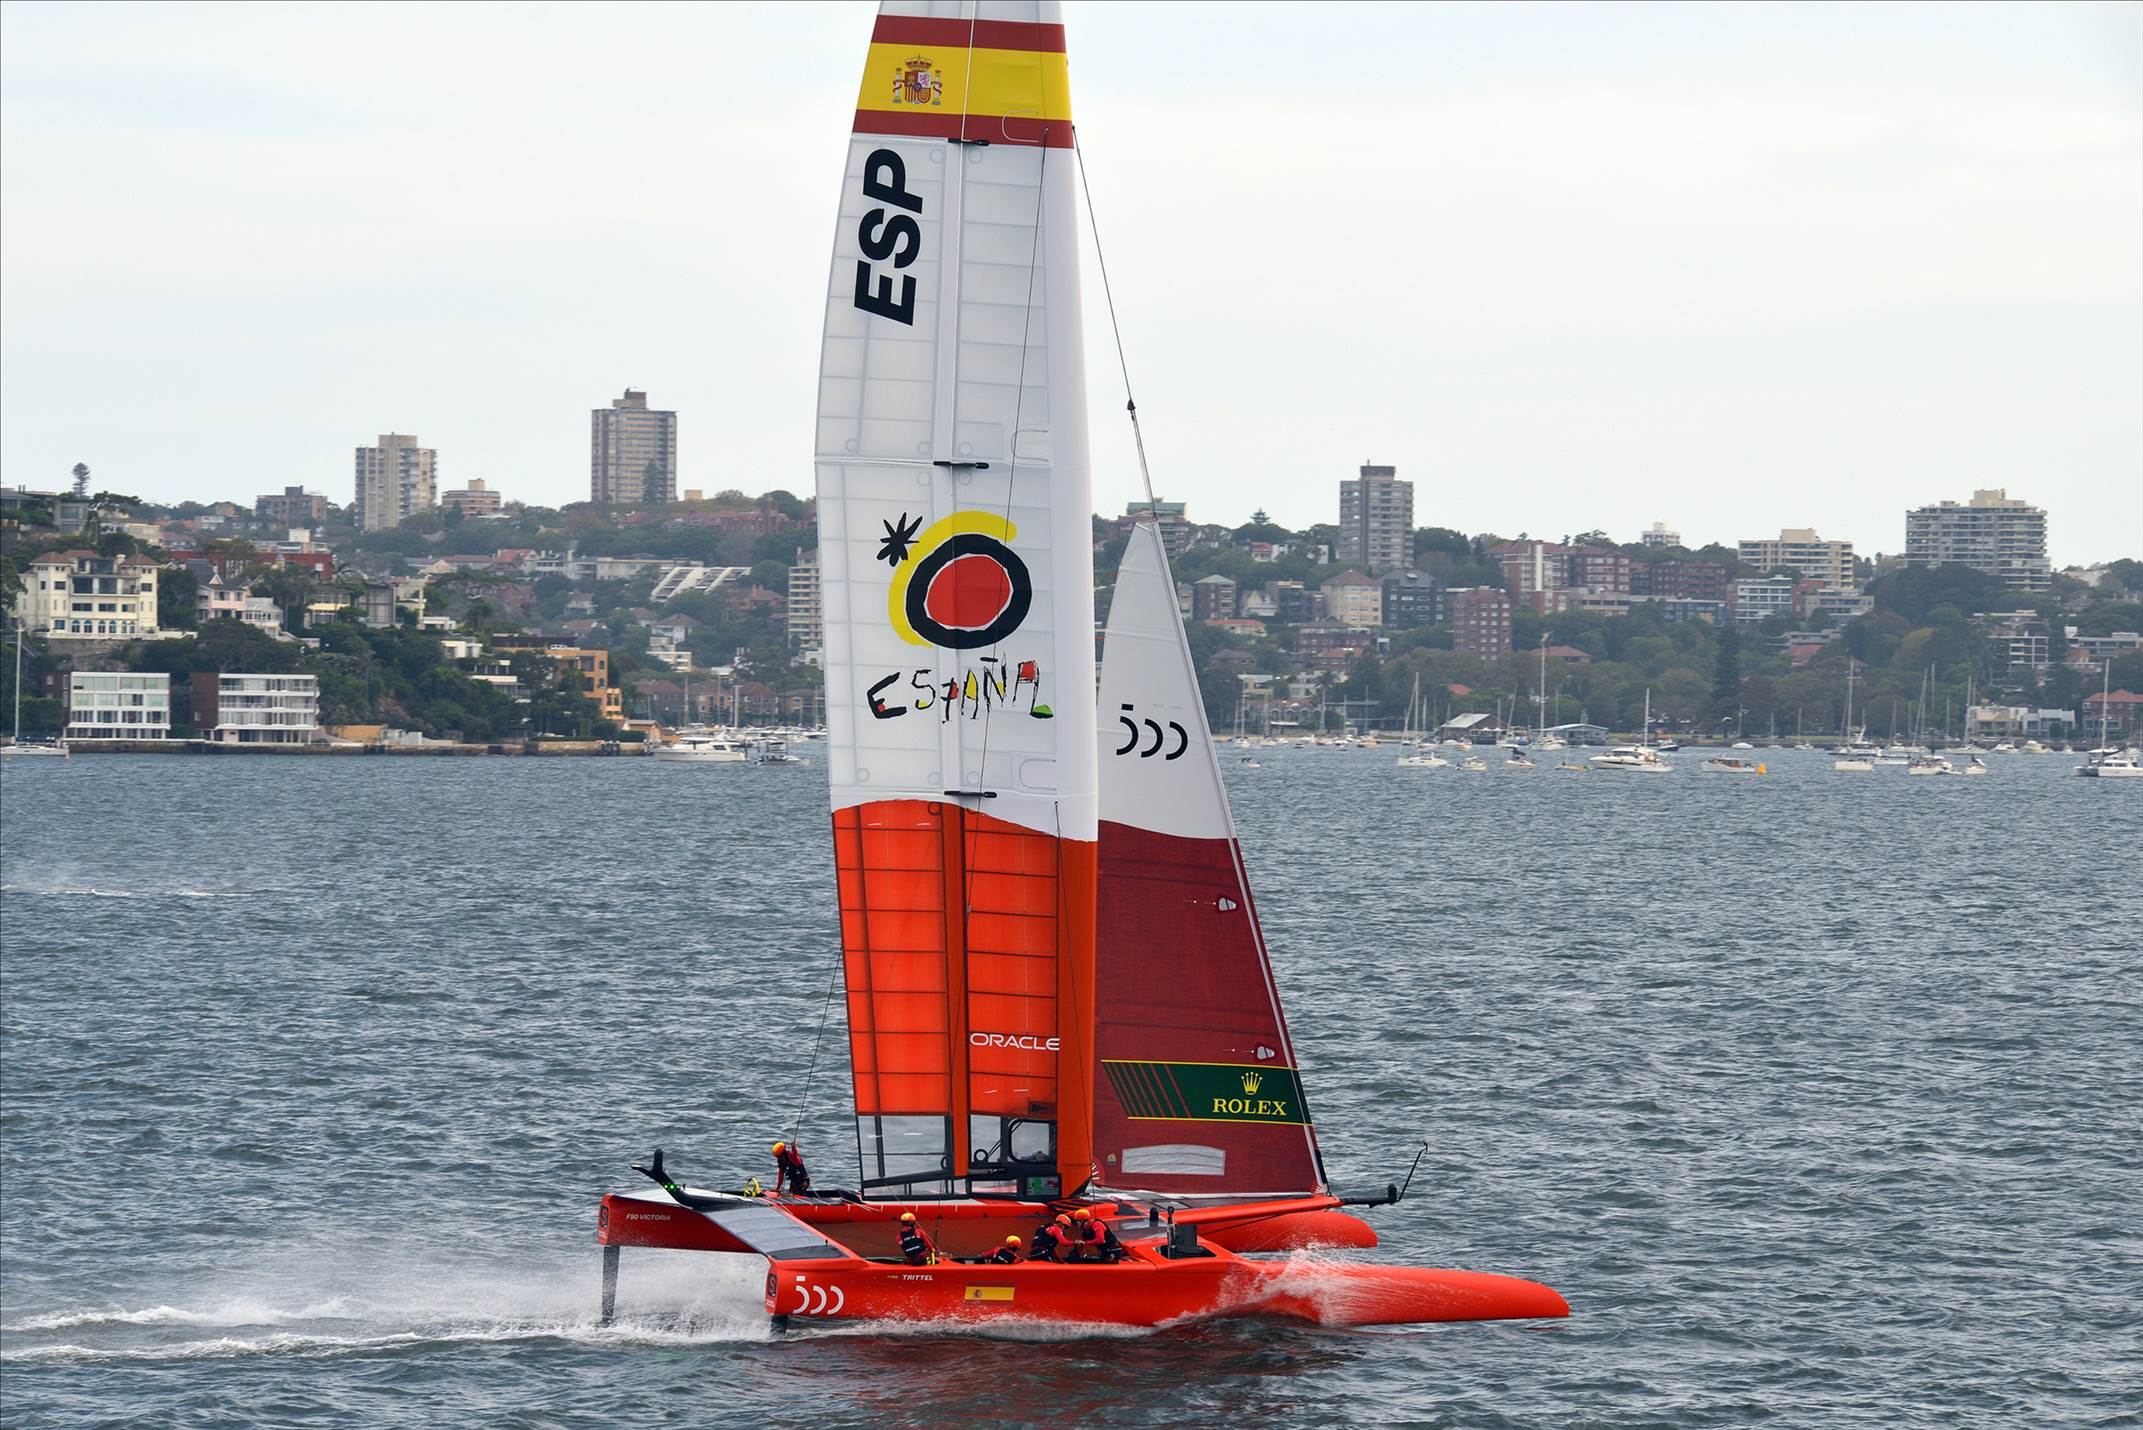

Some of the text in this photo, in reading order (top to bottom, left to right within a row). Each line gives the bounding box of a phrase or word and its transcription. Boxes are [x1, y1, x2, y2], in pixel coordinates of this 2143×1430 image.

[854, 148, 923, 326] ESP
[867, 652, 1054, 725] ESPAÑA
[970, 1032, 1060, 1051] ORACLE
[1212, 1098, 1287, 1116] ROLEX
[902, 1273, 934, 1281] TRITTEL
